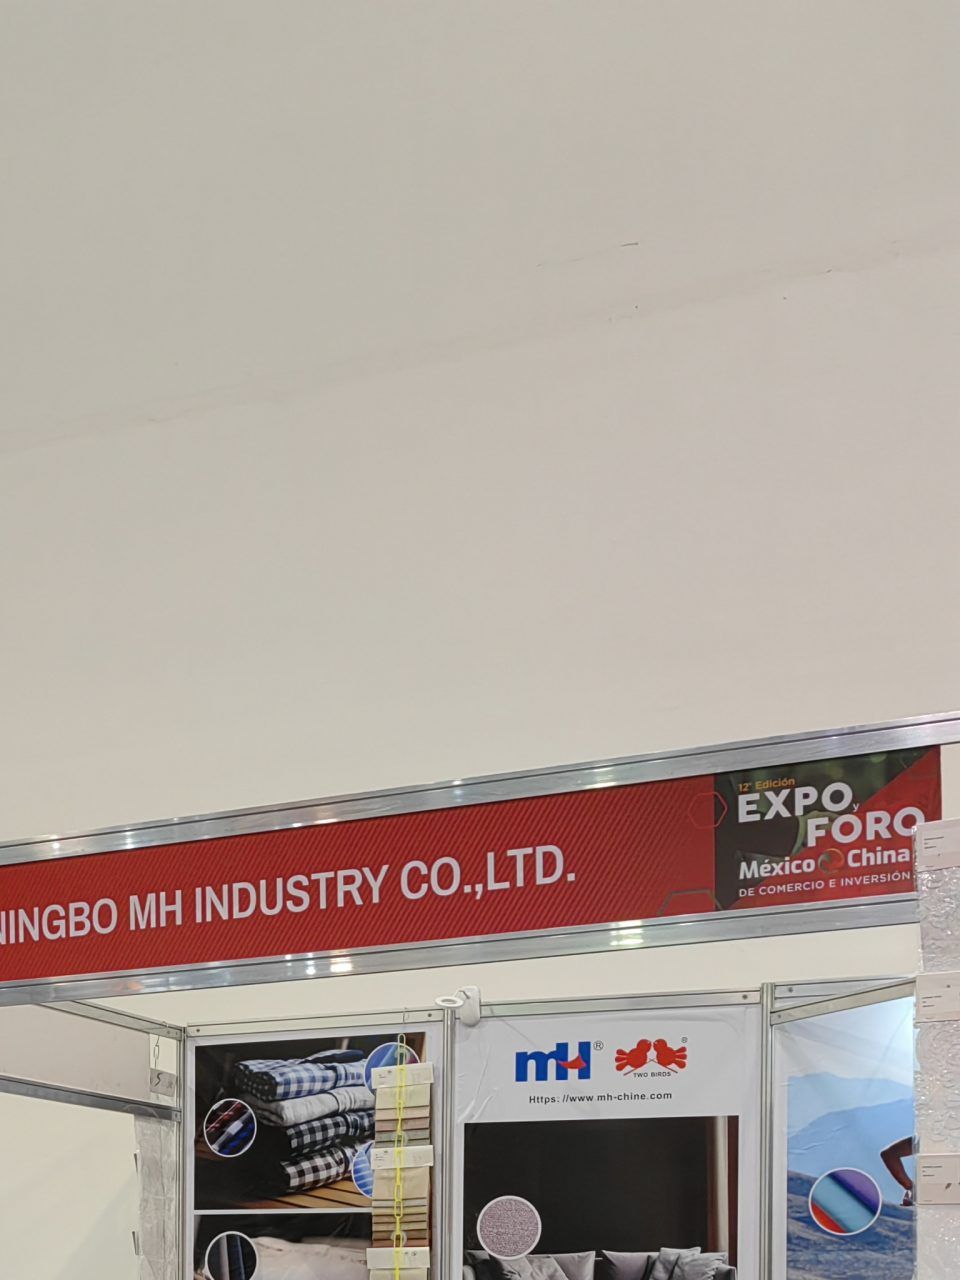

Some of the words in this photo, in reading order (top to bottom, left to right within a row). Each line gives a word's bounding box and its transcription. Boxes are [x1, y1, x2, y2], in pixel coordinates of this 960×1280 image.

[755, 777, 795, 790] Edición
[738, 782, 853, 823] EXPO
[852, 803, 860, 812] y
[807, 806, 925, 847] FORO
[739, 857, 816, 879] México
[847, 847, 910, 867] China
[129, 890, 182, 931] MH
[195, 864, 390, 923] INDUSTRY
[400, 844, 576, 900] CO.,LTD.
[739, 887, 755, 897] DE
[759, 880, 824, 895] COMERCIO
[829, 879, 836, 888] E
[841, 871, 911, 886] INVERSIÓN
